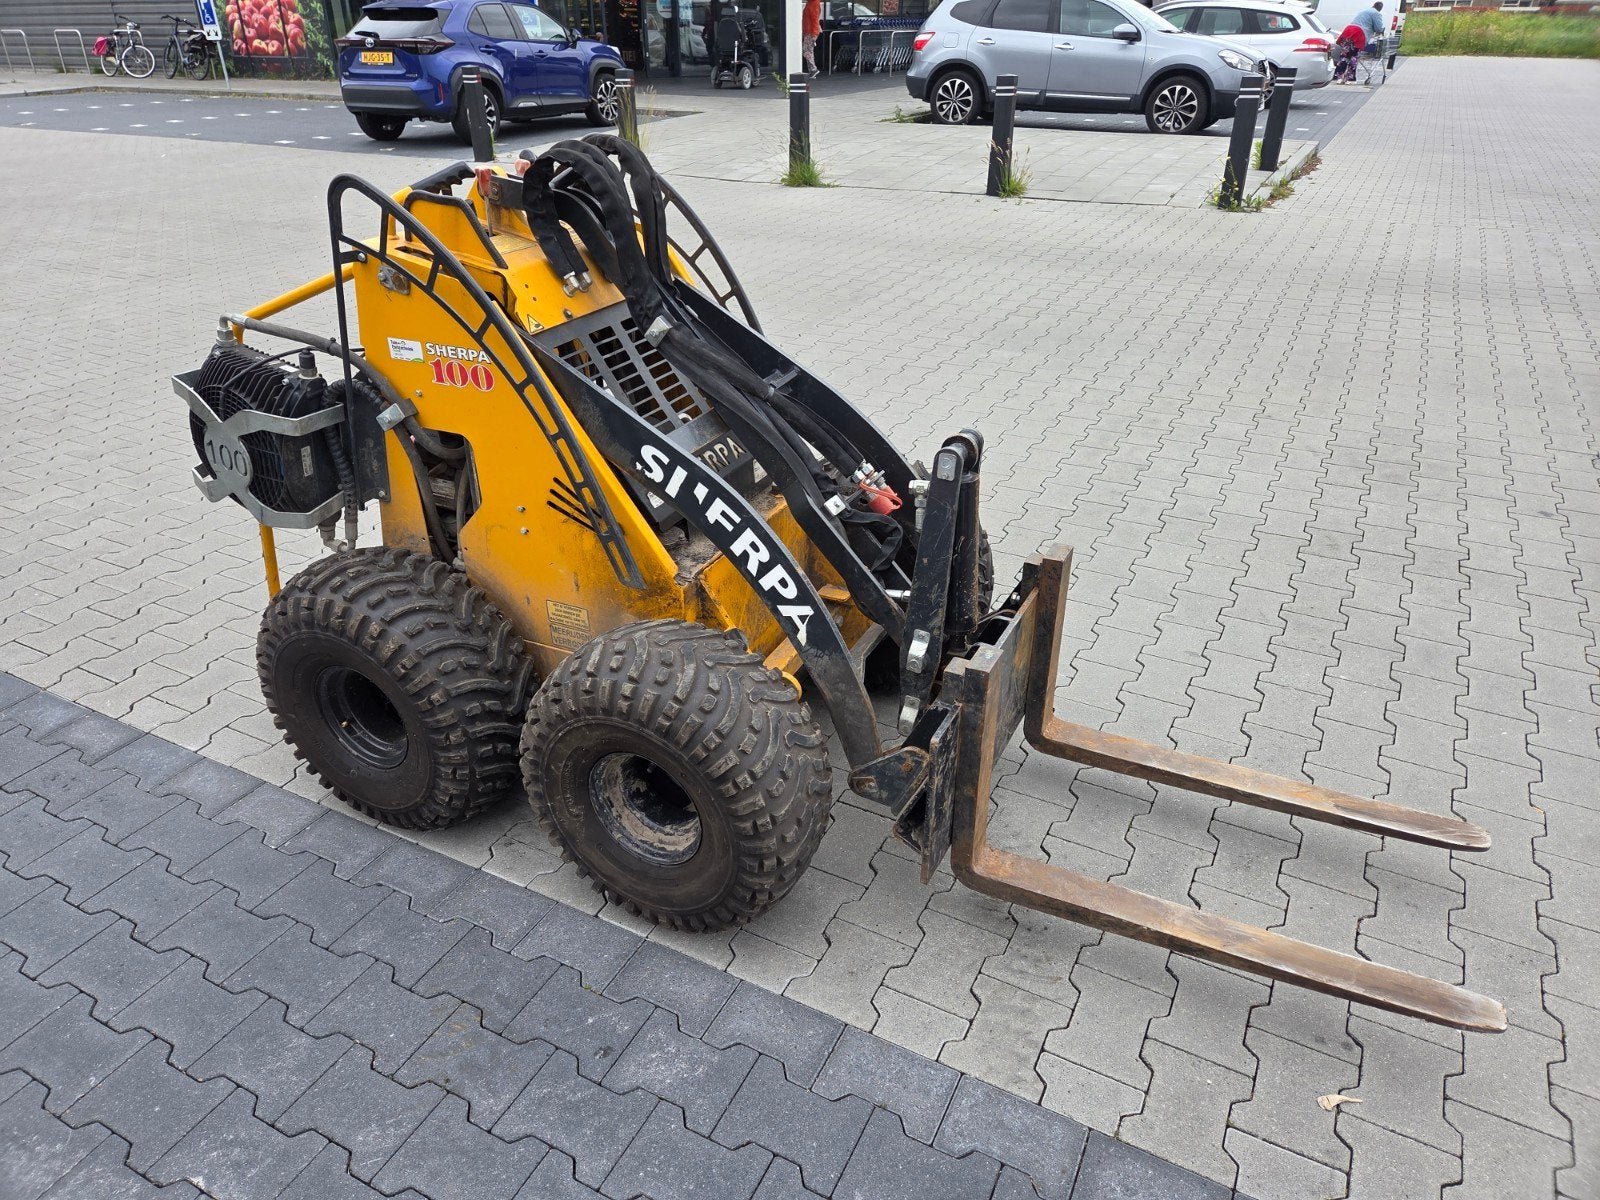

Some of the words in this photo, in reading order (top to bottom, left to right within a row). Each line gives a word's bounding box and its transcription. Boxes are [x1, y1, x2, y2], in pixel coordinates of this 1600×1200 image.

[425, 341, 491, 364] SHERPA
[429, 358, 495, 392] 100
[206, 439, 248, 477] 100
[698, 437, 746, 472] RPA
